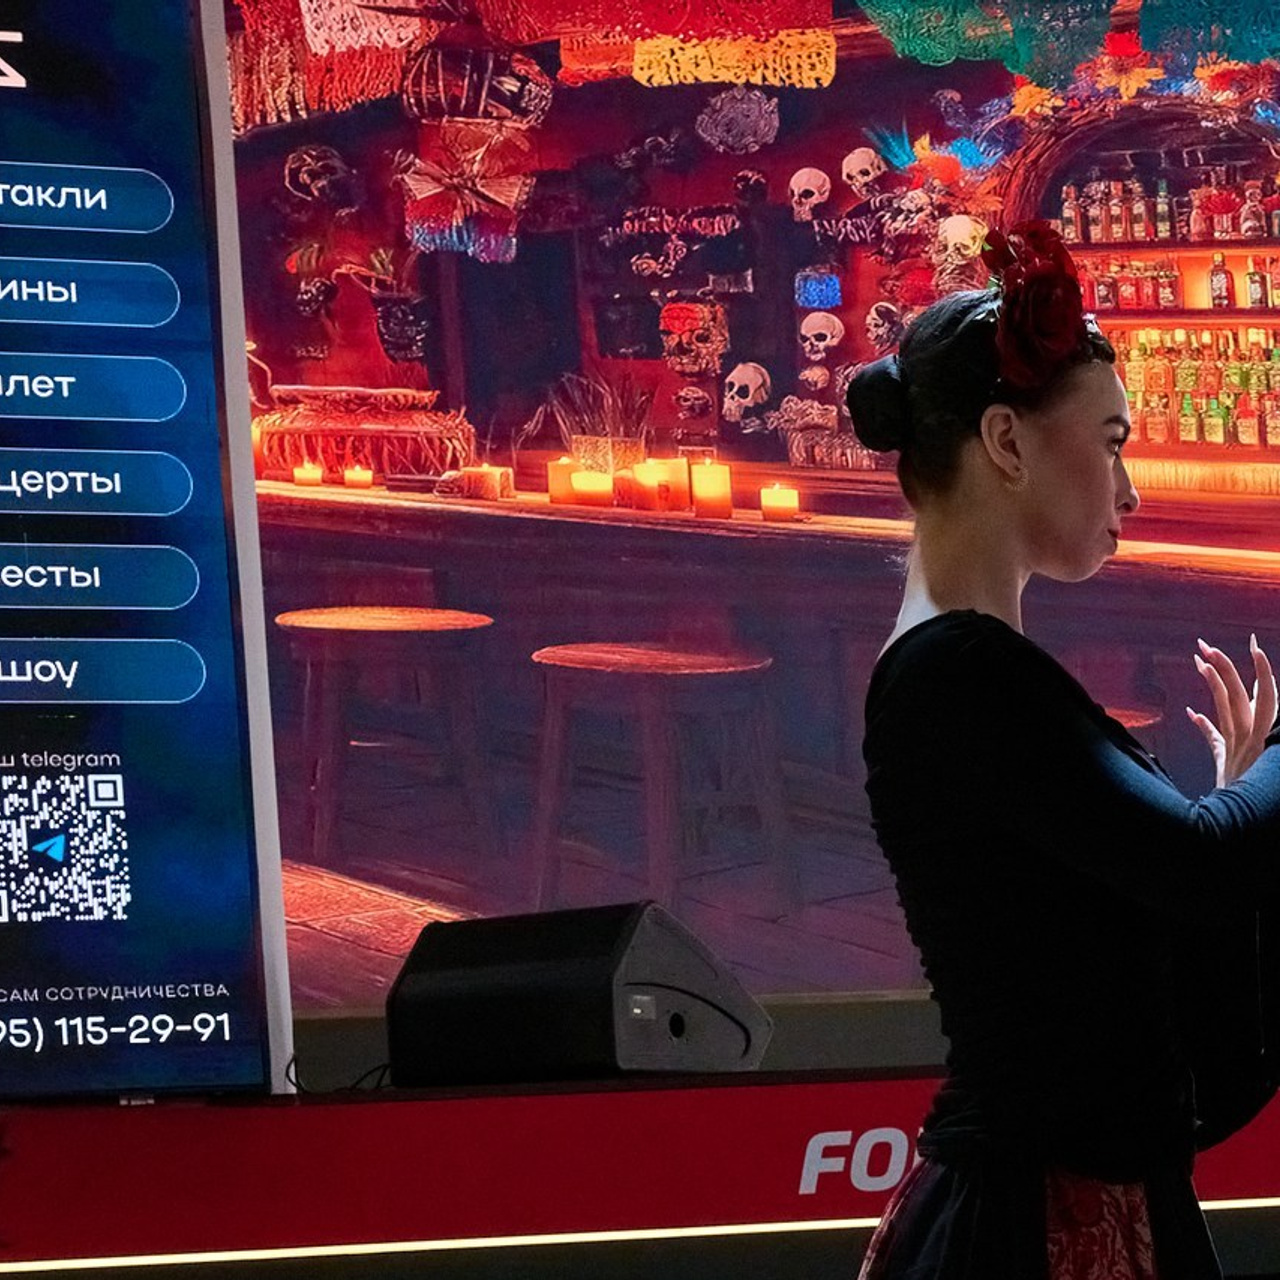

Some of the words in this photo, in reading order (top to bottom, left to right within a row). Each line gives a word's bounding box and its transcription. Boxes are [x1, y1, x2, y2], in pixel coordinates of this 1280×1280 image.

[0, 564, 101, 588] есты
[0, 660, 79, 688] шоу
[22, 751, 121, 772] telegram
[45, 983, 230, 1001] СОТРУДНИЧЕСТВА
[54, 1012, 231, 1046] 115-29-91
[798, 1126, 924, 1195] FO
